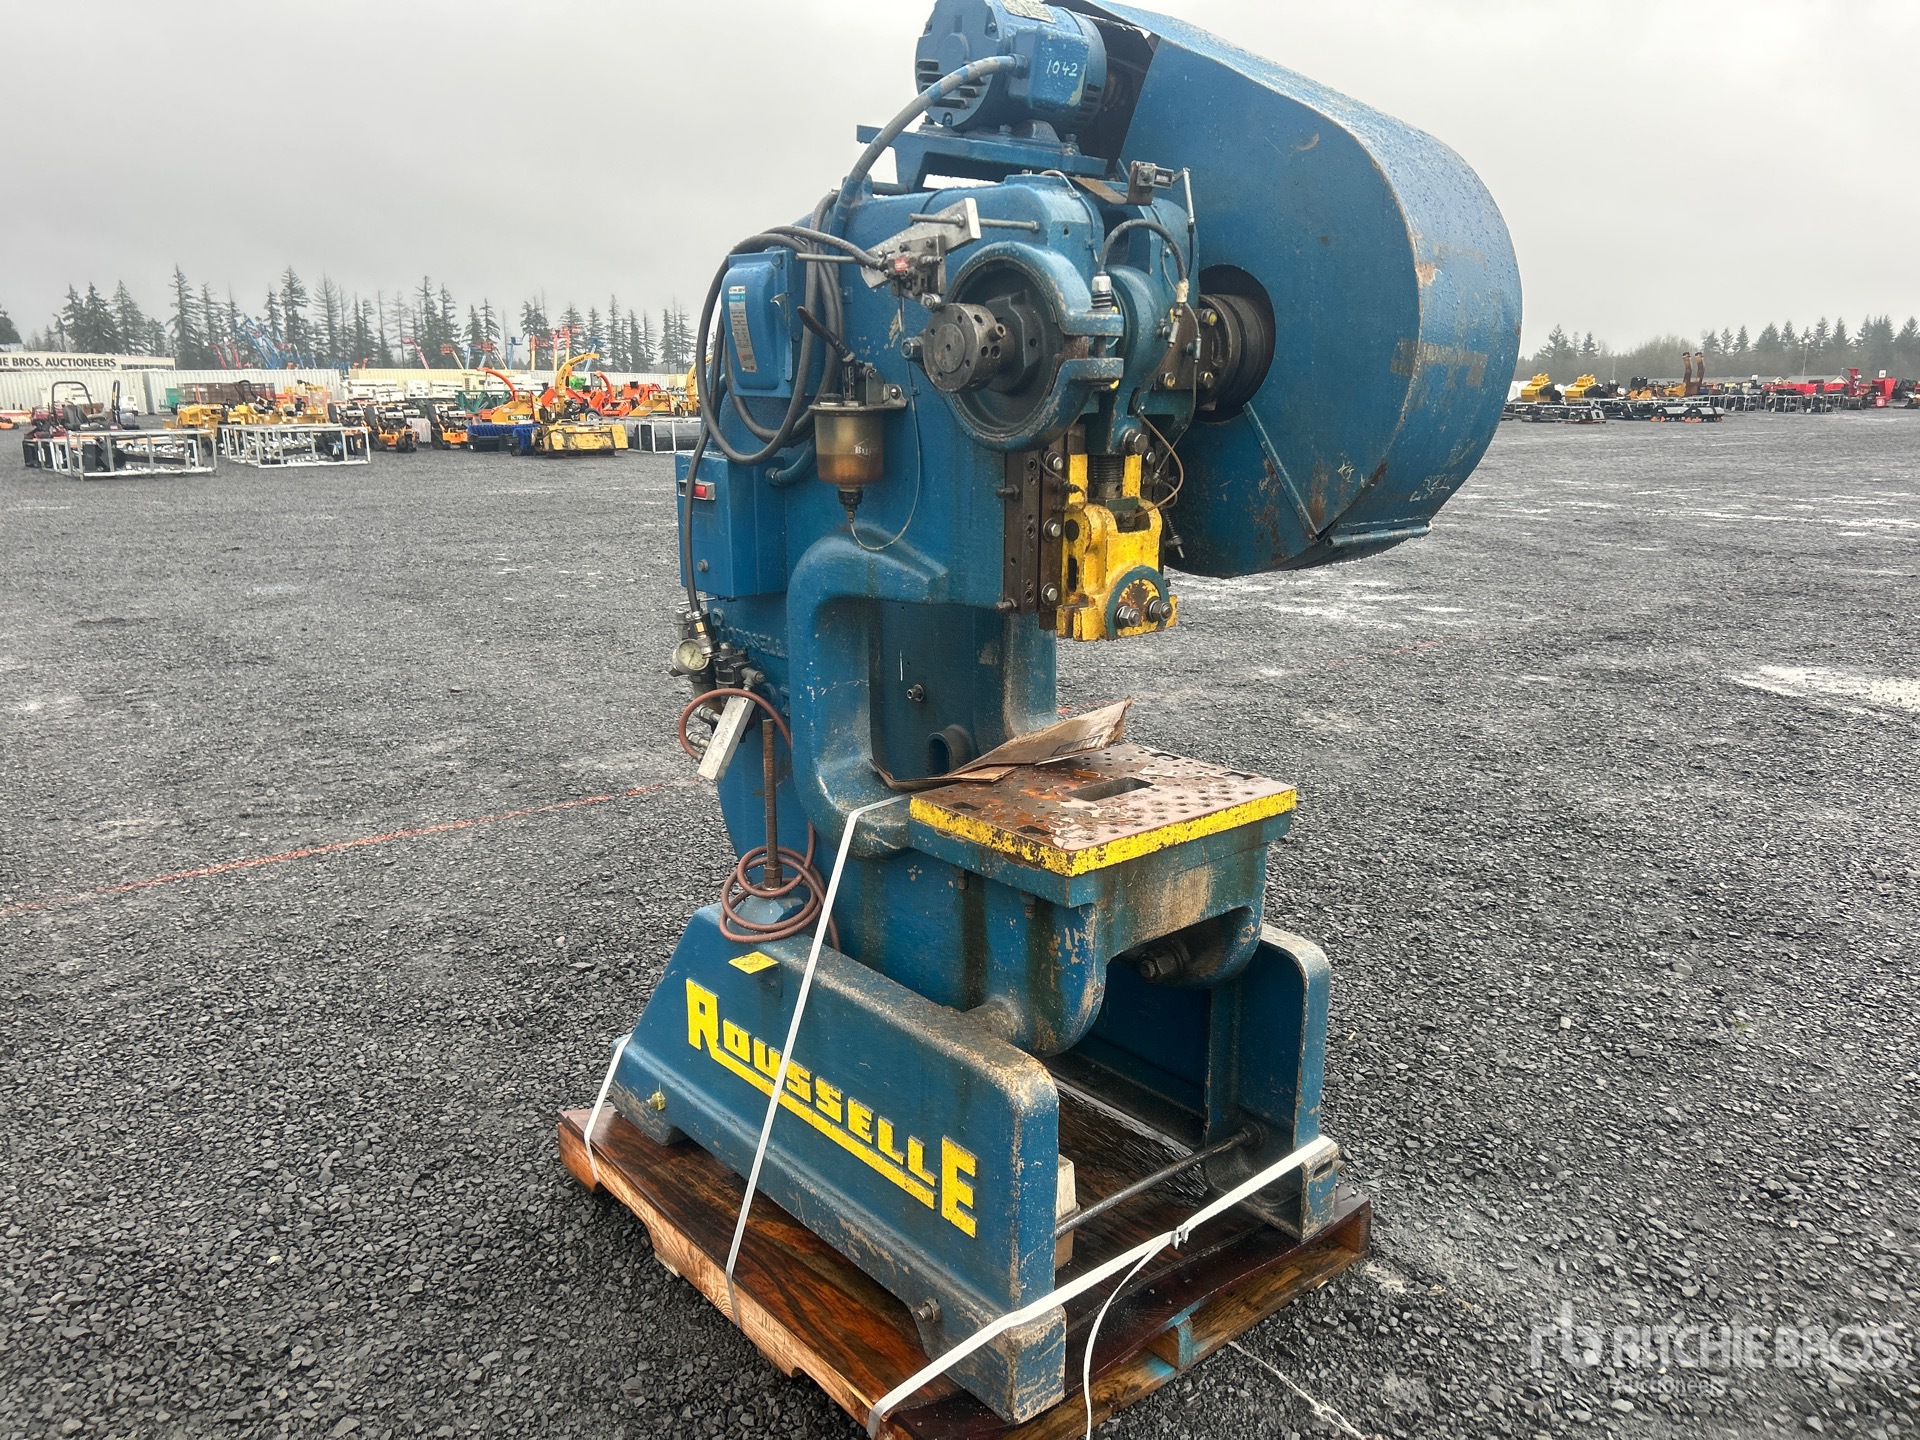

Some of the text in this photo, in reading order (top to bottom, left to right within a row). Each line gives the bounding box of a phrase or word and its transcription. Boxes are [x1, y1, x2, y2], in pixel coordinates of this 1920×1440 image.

[1045, 59, 1078, 77] 1042
[12, 357, 43, 367] BROS.
[45, 357, 117, 368] AUCTIONEERS
[685, 977, 979, 1239] ROUSSELLE
